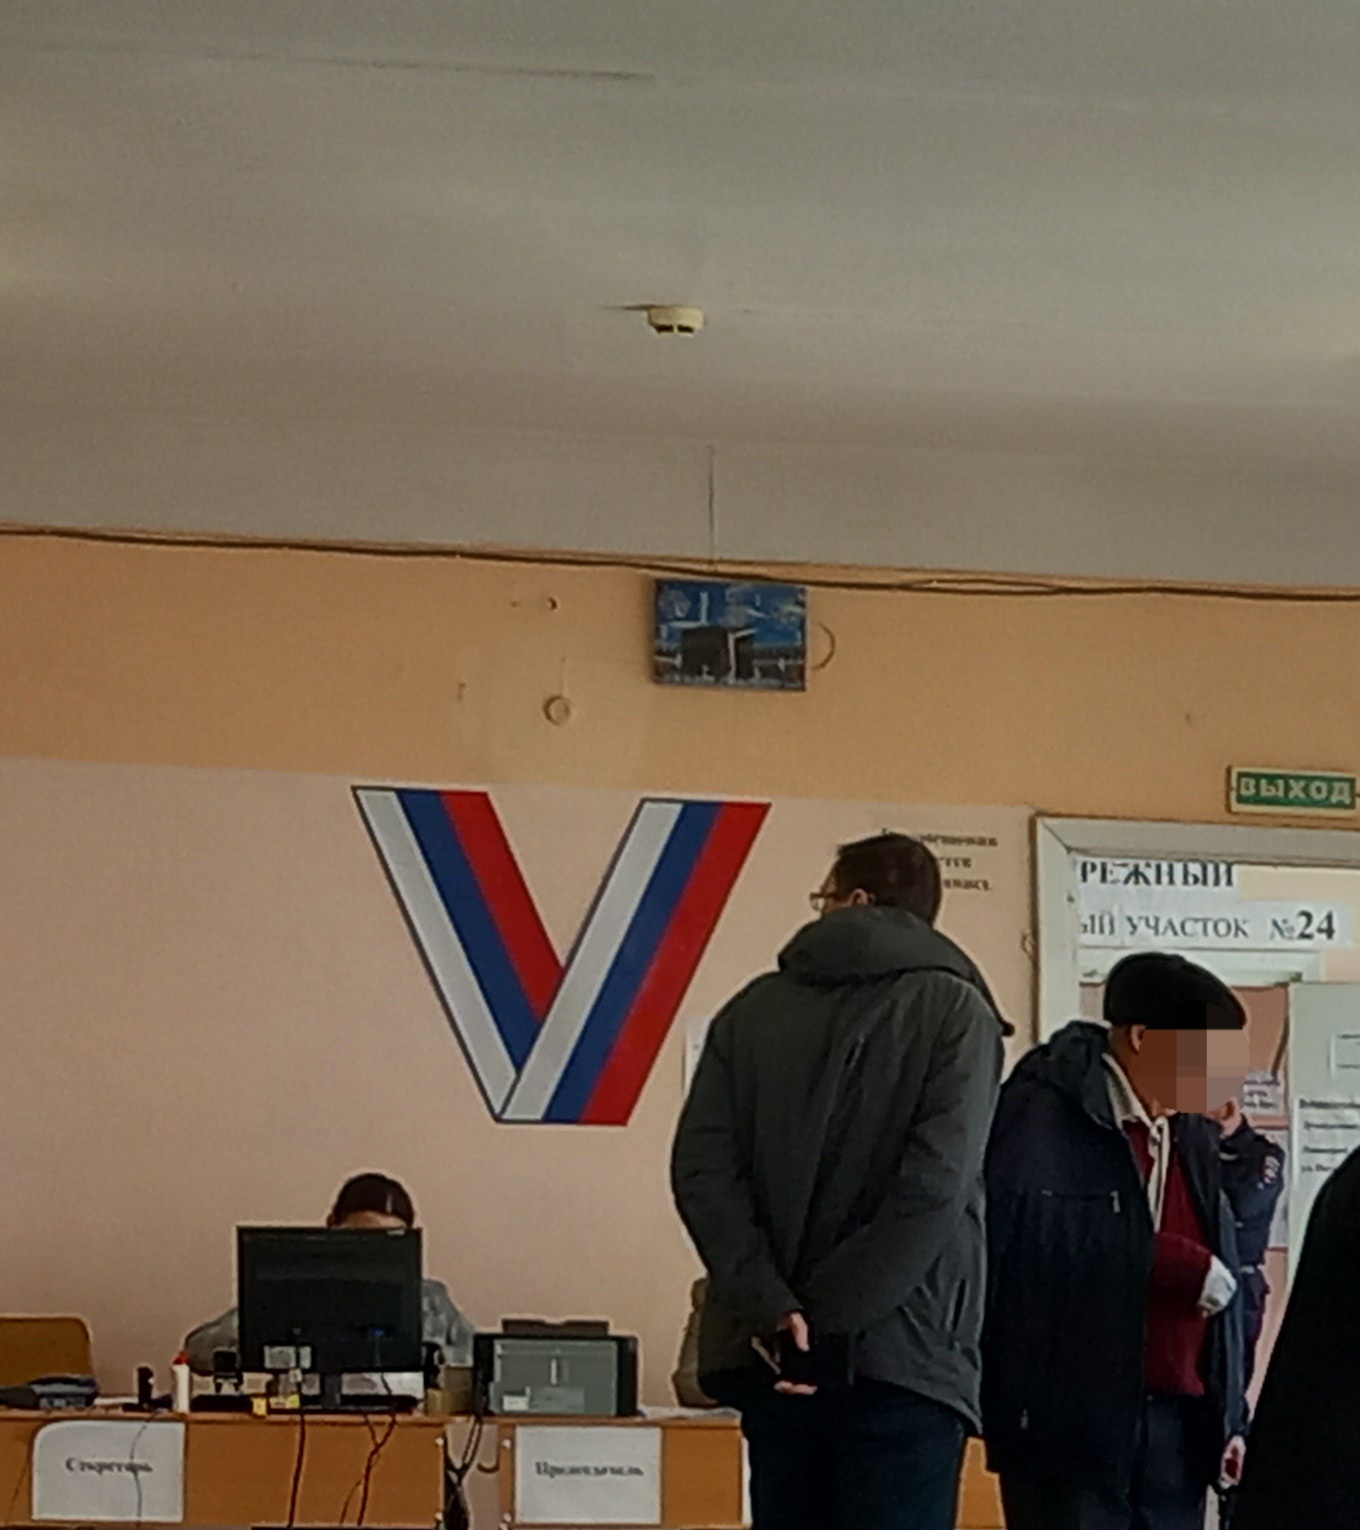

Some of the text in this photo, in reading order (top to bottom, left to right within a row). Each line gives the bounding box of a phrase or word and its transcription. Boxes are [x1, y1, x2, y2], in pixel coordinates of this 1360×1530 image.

[1239, 777, 1351, 805] ВЫХОД
[1126, 913, 1250, 939] УЧАСТОК
[351, 785, 772, 1126] V
